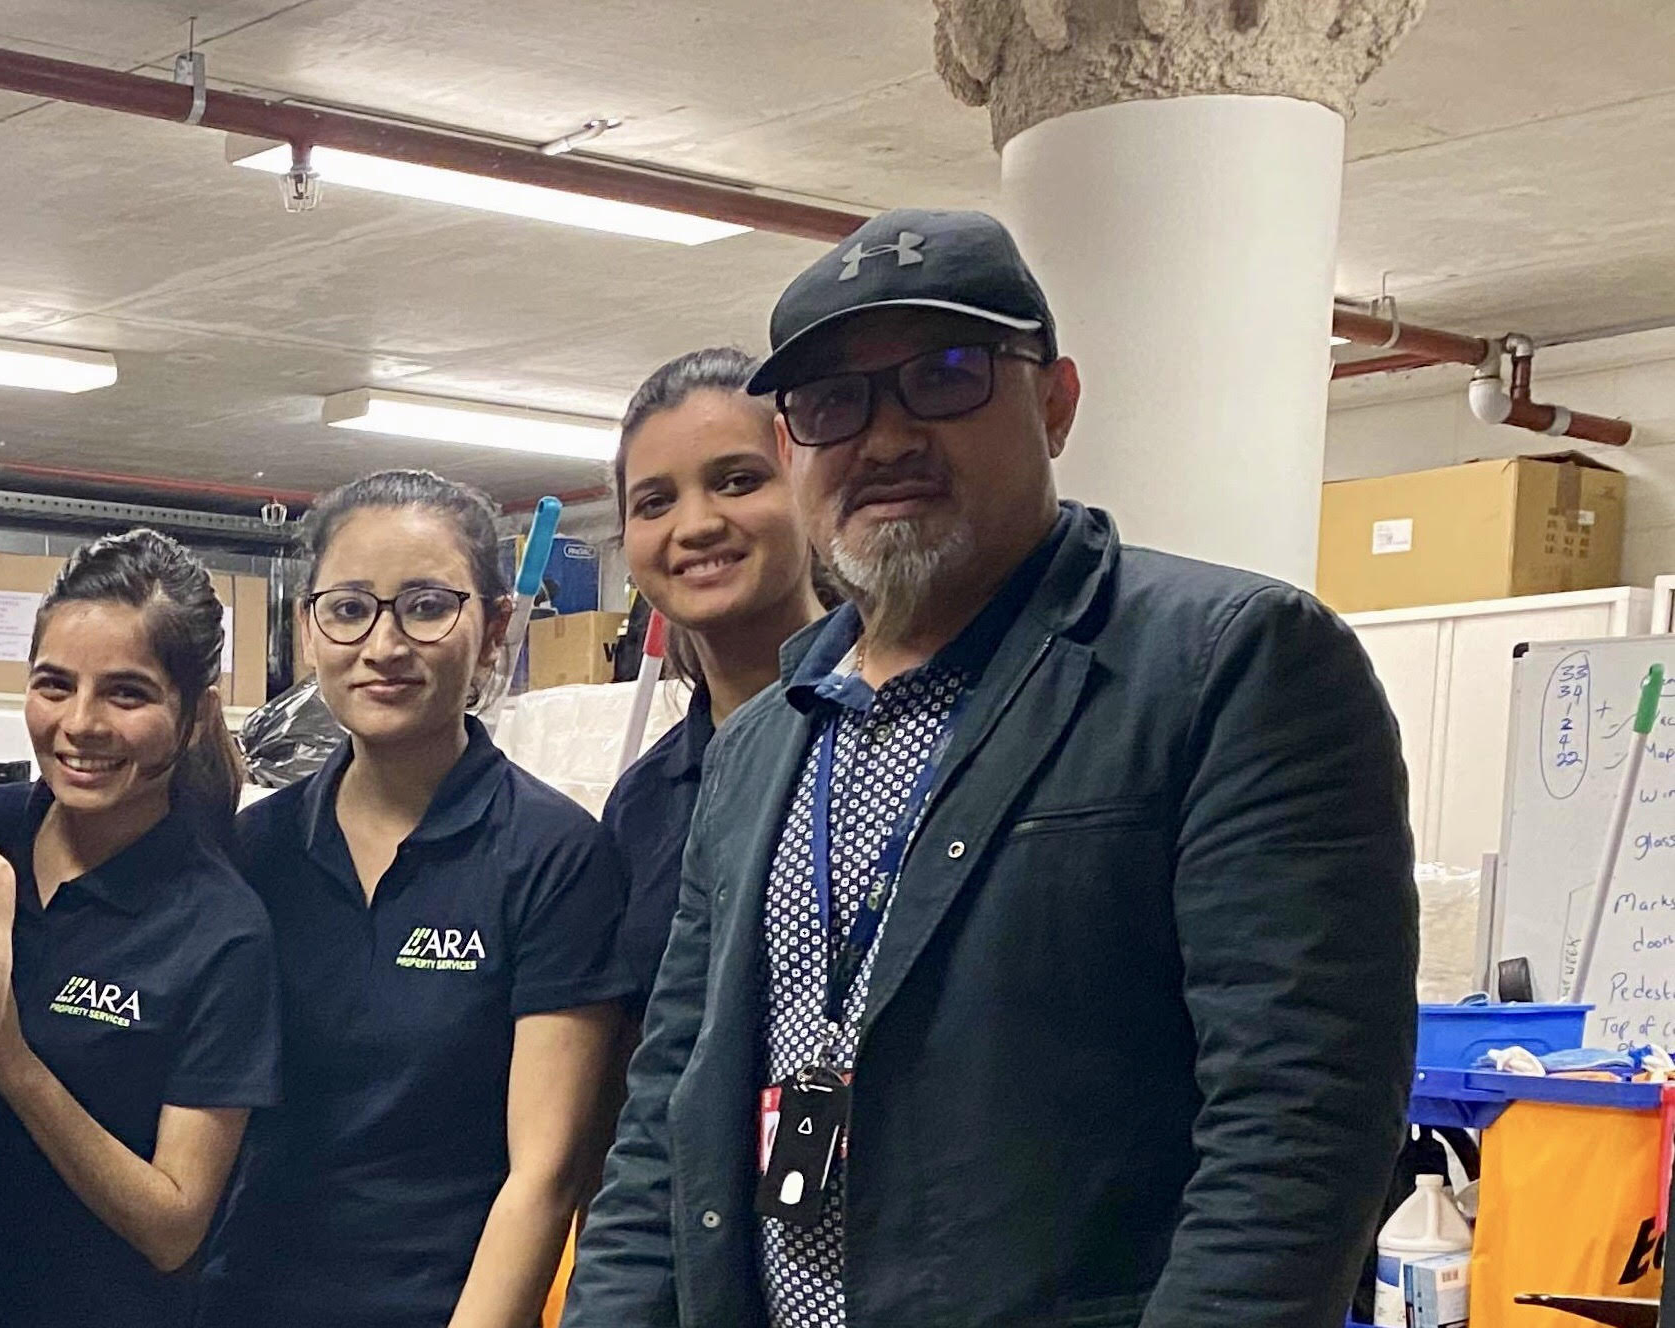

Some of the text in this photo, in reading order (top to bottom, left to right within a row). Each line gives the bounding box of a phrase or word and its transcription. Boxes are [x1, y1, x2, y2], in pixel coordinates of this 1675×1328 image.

[1559, 665, 1590, 682] 33
[1560, 717, 1573, 731] 2
[420, 928, 486, 958] ARA
[1609, 971, 1675, 1003] Pedest
[74, 980, 141, 1021] ARA
[49, 1002, 131, 1028] PROPERTY SERVICES
[1600, 1016, 1630, 1040] Top
